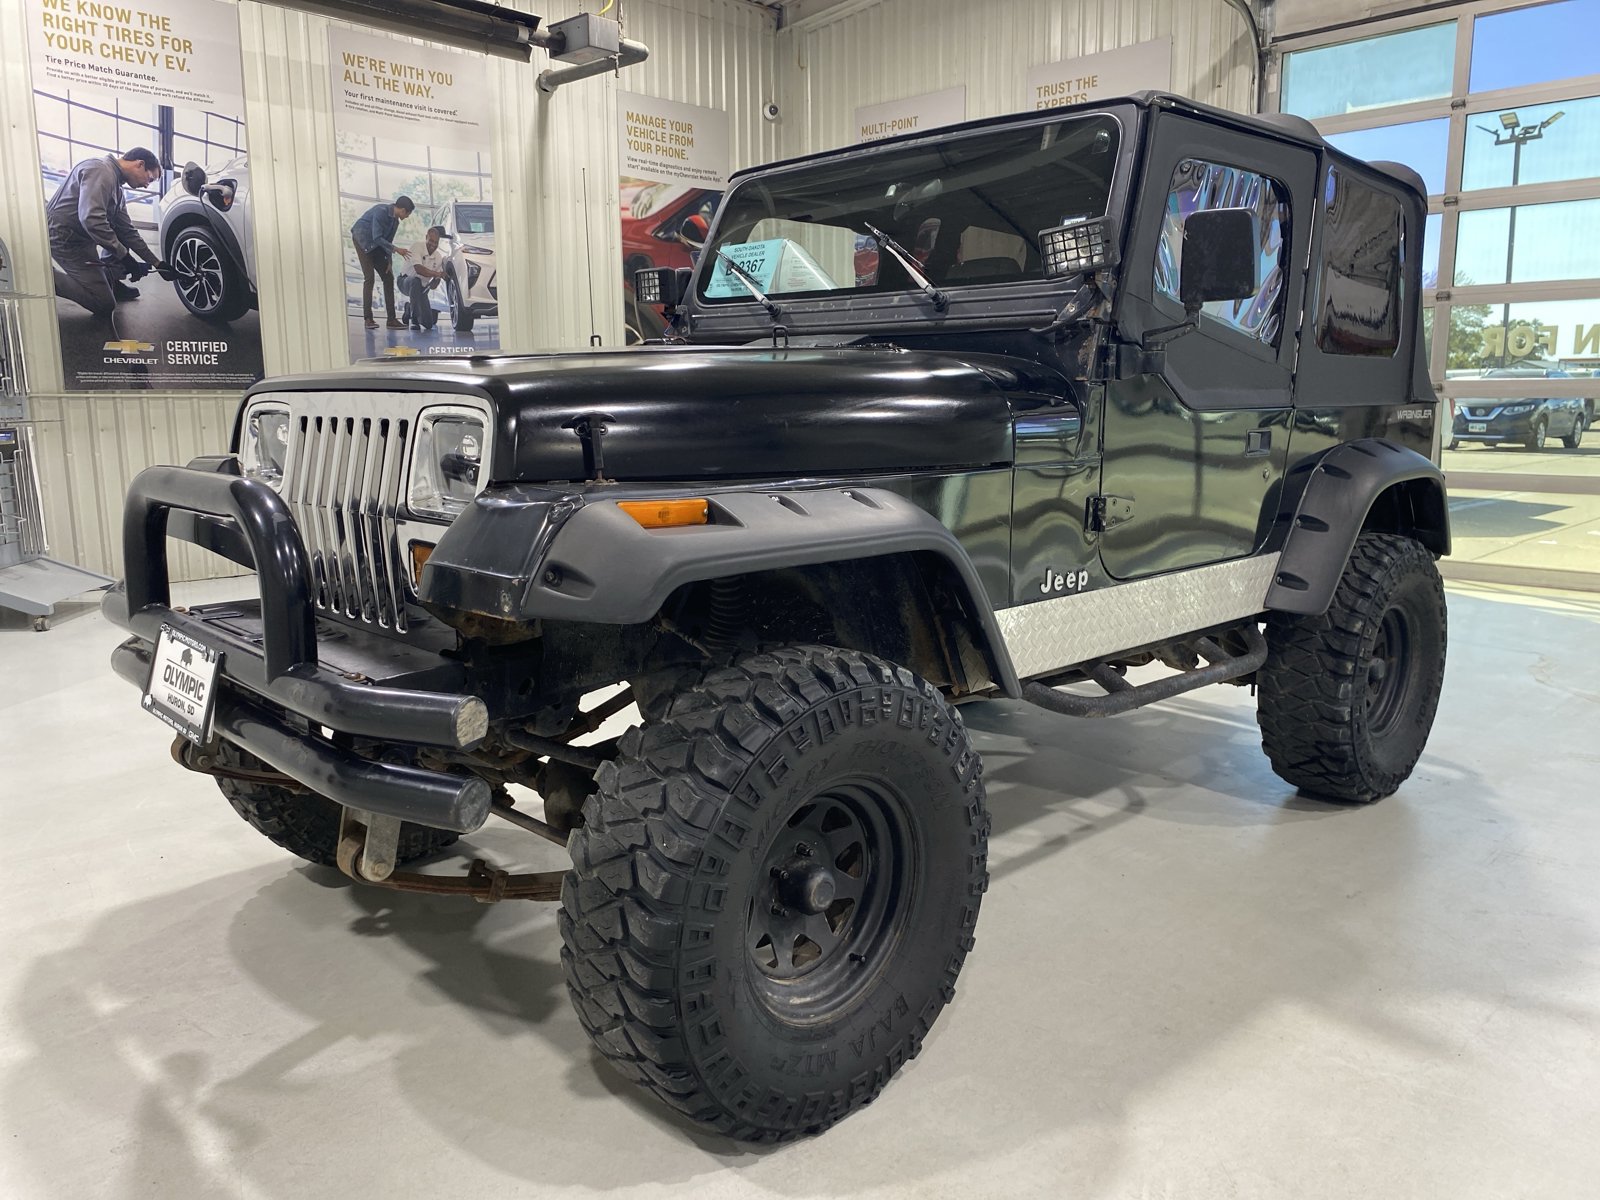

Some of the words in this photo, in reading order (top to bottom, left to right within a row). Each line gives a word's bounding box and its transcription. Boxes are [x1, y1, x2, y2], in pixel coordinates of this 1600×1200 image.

[43, 0, 71, 12] WE
[77, 0, 131, 24] KNOW
[137, 11, 171, 32] THE
[43, 12, 98, 36] RIGHT
[103, 24, 155, 47] TIRES
[160, 35, 193, 54] FOR
[43, 31, 94, 55] YOUR
[100, 42, 159, 67] CHEVY
[165, 54, 191, 72] EV.
[45, 54, 62, 65] Tire
[64, 58, 86, 69] Price
[88, 63, 113, 74] Match
[115, 68, 158, 82] Guarantee.
[342, 52, 386, 74] WE'RE
[390, 62, 425, 81] WITH
[428, 71, 453, 86] YOU
[343, 69, 370, 87] ALL
[373, 75, 400, 93] THE
[403, 81, 435, 99] WAY.
[1036, 80, 1072, 98] TRUST
[1075, 75, 1098, 91] THE
[344, 89, 359, 99] Your
[360, 92, 374, 101] first
[375, 97, 413, 109] maintenance
[414, 103, 427, 111] visit
[1036, 92, 1088, 110] EXPERTS
[626, 111, 667, 129] MANAGE
[669, 119, 693, 134] YOUR
[861, 116, 919, 136] MULTI-POINT
[626, 125, 667, 143] VEHICLE
[669, 134, 694, 148] FROM
[627, 138, 653, 154] YOUR
[655, 145, 689, 160] PHONE.
[638, 158, 658, 167] real-time
[659, 161, 683, 171] diagnostics
[691, 167, 702, 175] enjoy
[640, 166, 659, 174] available
[748, 250, 765, 258] DEALER
[166, 340, 228, 353] CERTIFIED
[103, 357, 158, 365] CHEVROLET
[167, 354, 219, 365] SERVICE
[1397, 409, 1433, 421] WRANGLER
[1040, 568, 1088, 594] Jeep
[163, 664, 205, 702] OLYMPIC
[166, 693, 187, 713] HURON,
[187, 703, 195, 716] SD
[188, 730, 200, 743] GMC
